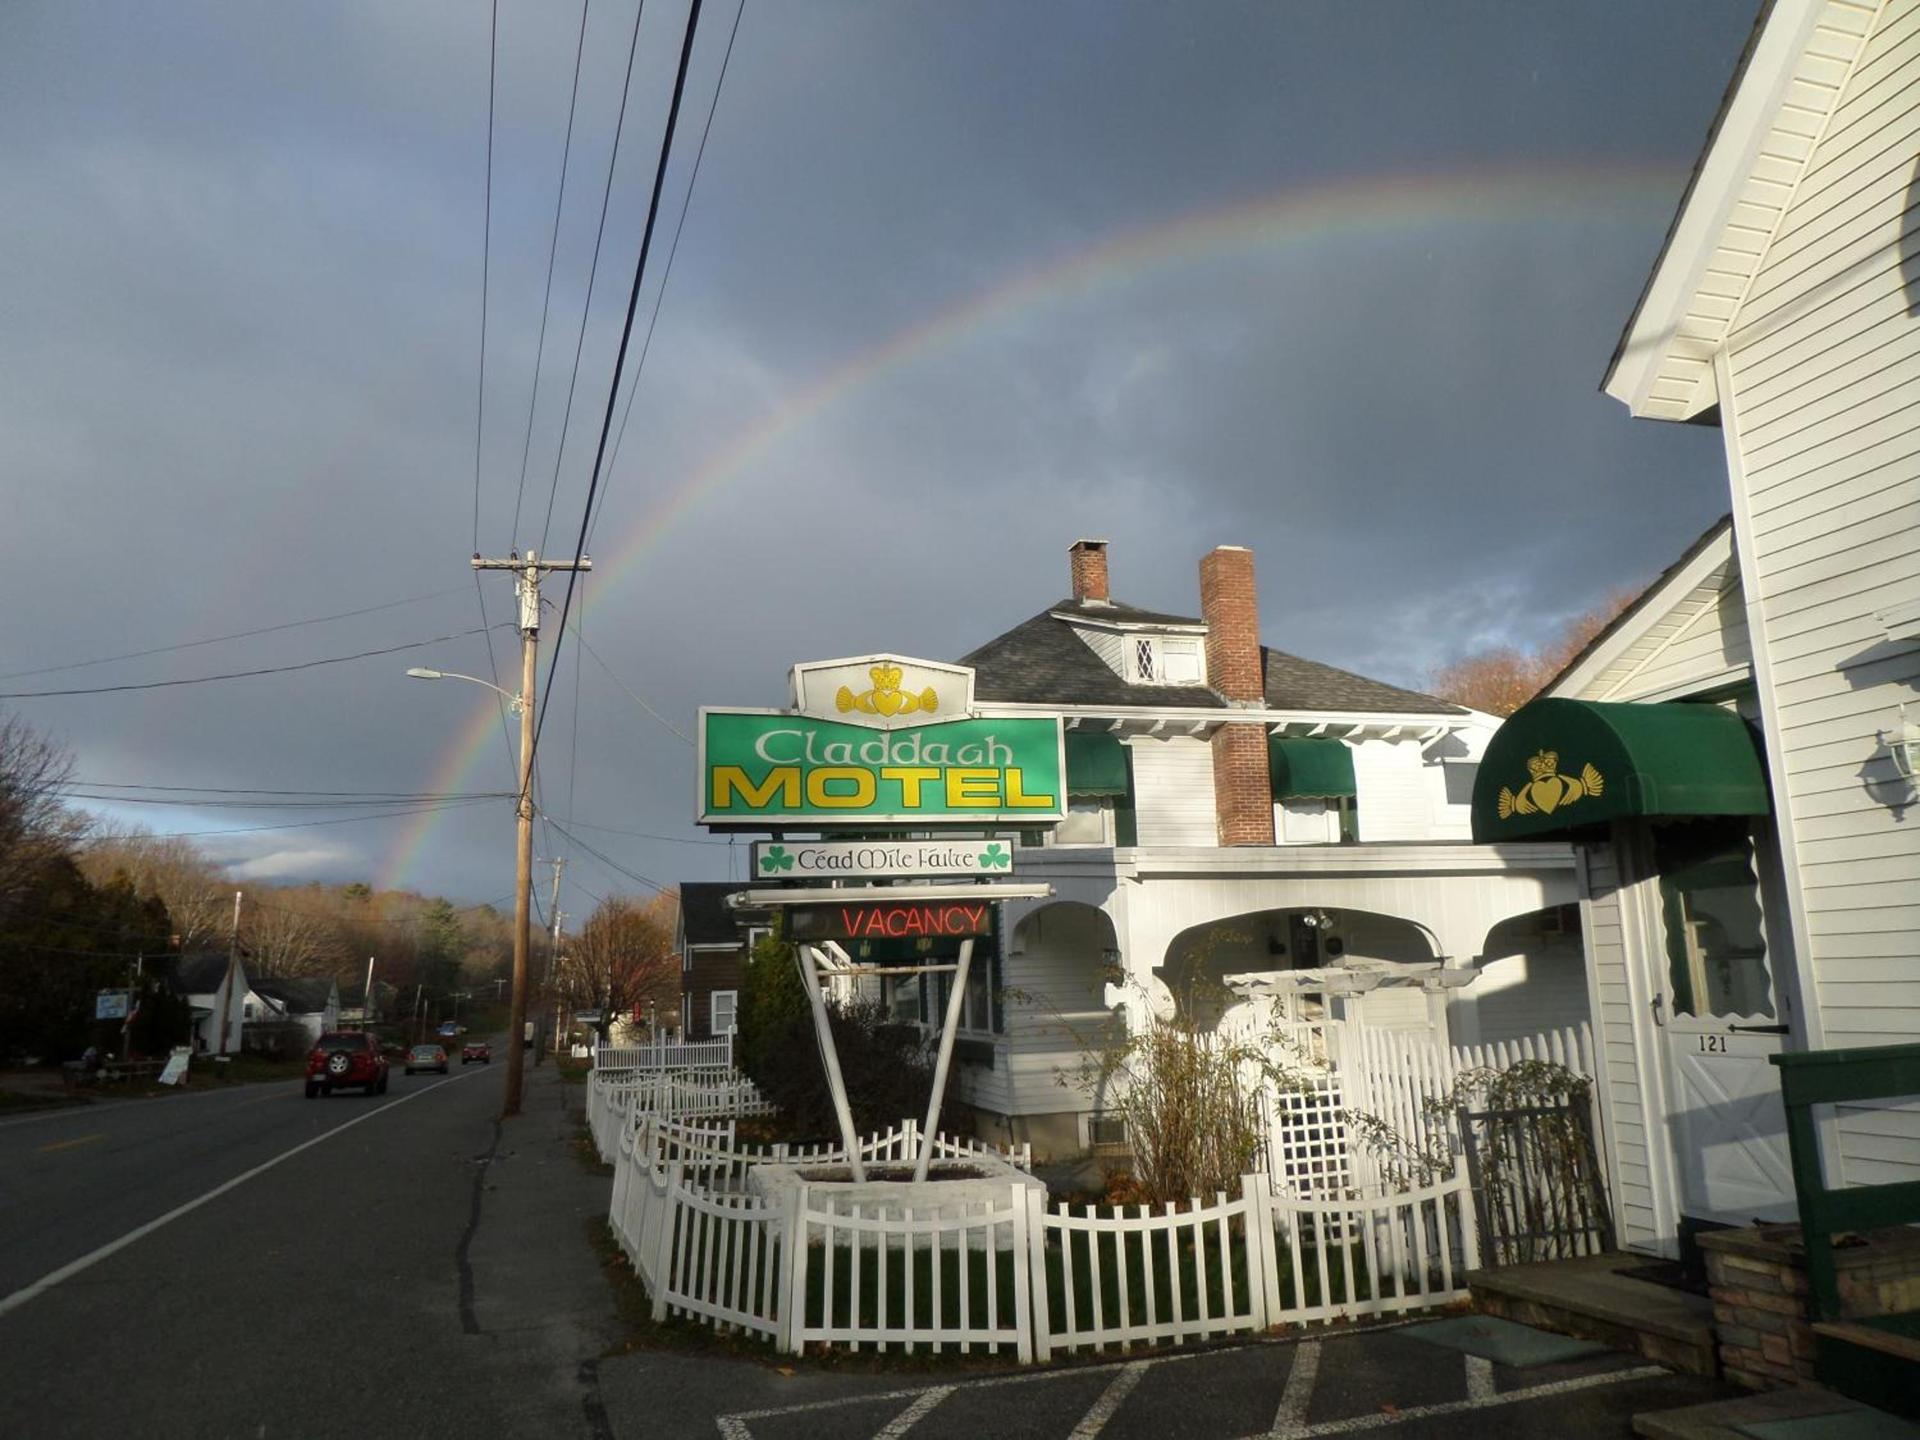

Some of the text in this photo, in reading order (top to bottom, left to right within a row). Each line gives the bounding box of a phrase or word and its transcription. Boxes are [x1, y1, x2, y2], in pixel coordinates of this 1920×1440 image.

[755, 730, 1013, 765] Claddagh
[711, 765, 1055, 809] MOTEL
[798, 848, 853, 870] Céad
[842, 905, 984, 937] VACANCY
[1700, 1035, 1727, 1052] 121
